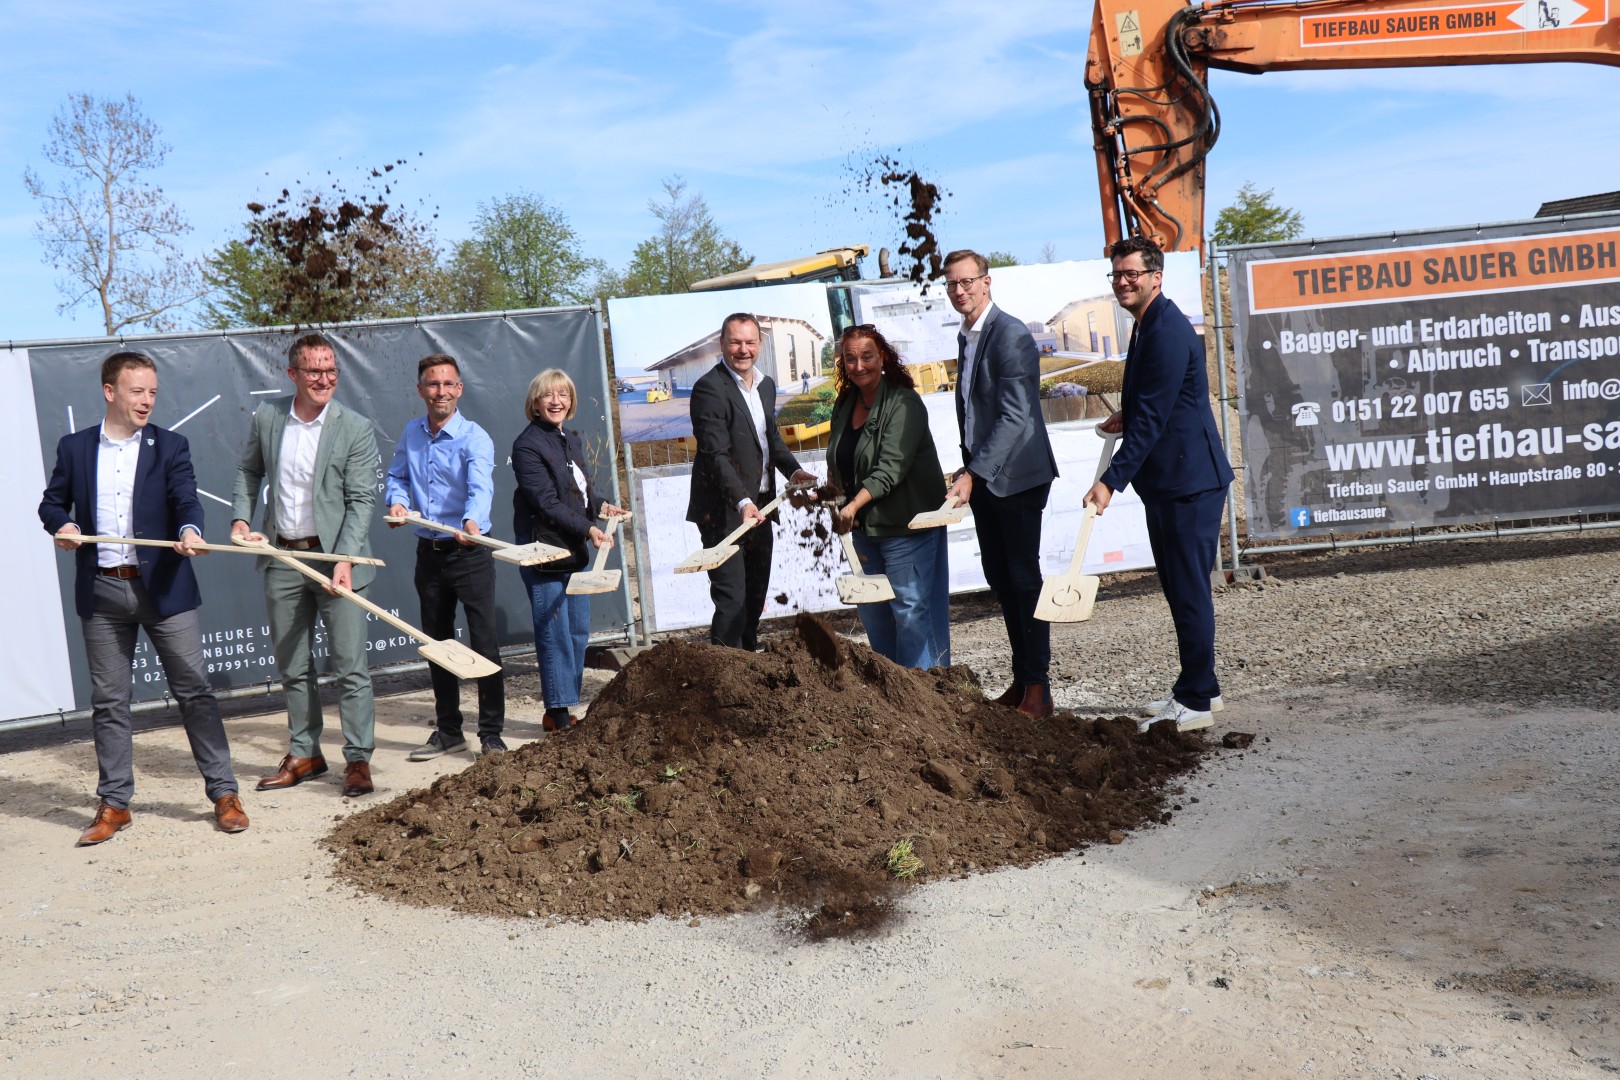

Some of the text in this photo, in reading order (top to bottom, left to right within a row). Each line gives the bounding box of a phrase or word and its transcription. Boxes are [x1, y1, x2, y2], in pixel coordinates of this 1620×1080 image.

[1313, 11, 1496, 38] TIEFBAU SAUER GMBH
[1293, 241, 1617, 296] TIEFBAU SAUER GMBH
[1280, 304, 1620, 355] Bagger- und Erdarbeiten Aus
[1407, 335, 1620, 374] Abbruch Transpo
[1332, 378, 1620, 423] 0151 22 007 655 info@
[1325, 421, 1620, 472] www.tiefbau-sa
[1328, 482, 1383, 498] Tiefbau
[1388, 478, 1430, 495] Sauer
[1435, 472, 1478, 490] GmbH
[1489, 464, 1582, 486] Hauptstraße
[1586, 462, 1606, 478] 80
[1313, 506, 1387, 524] tiefbausauer
[203, 642, 255, 659] NBURG
[207, 655, 276, 674] 87991-00
